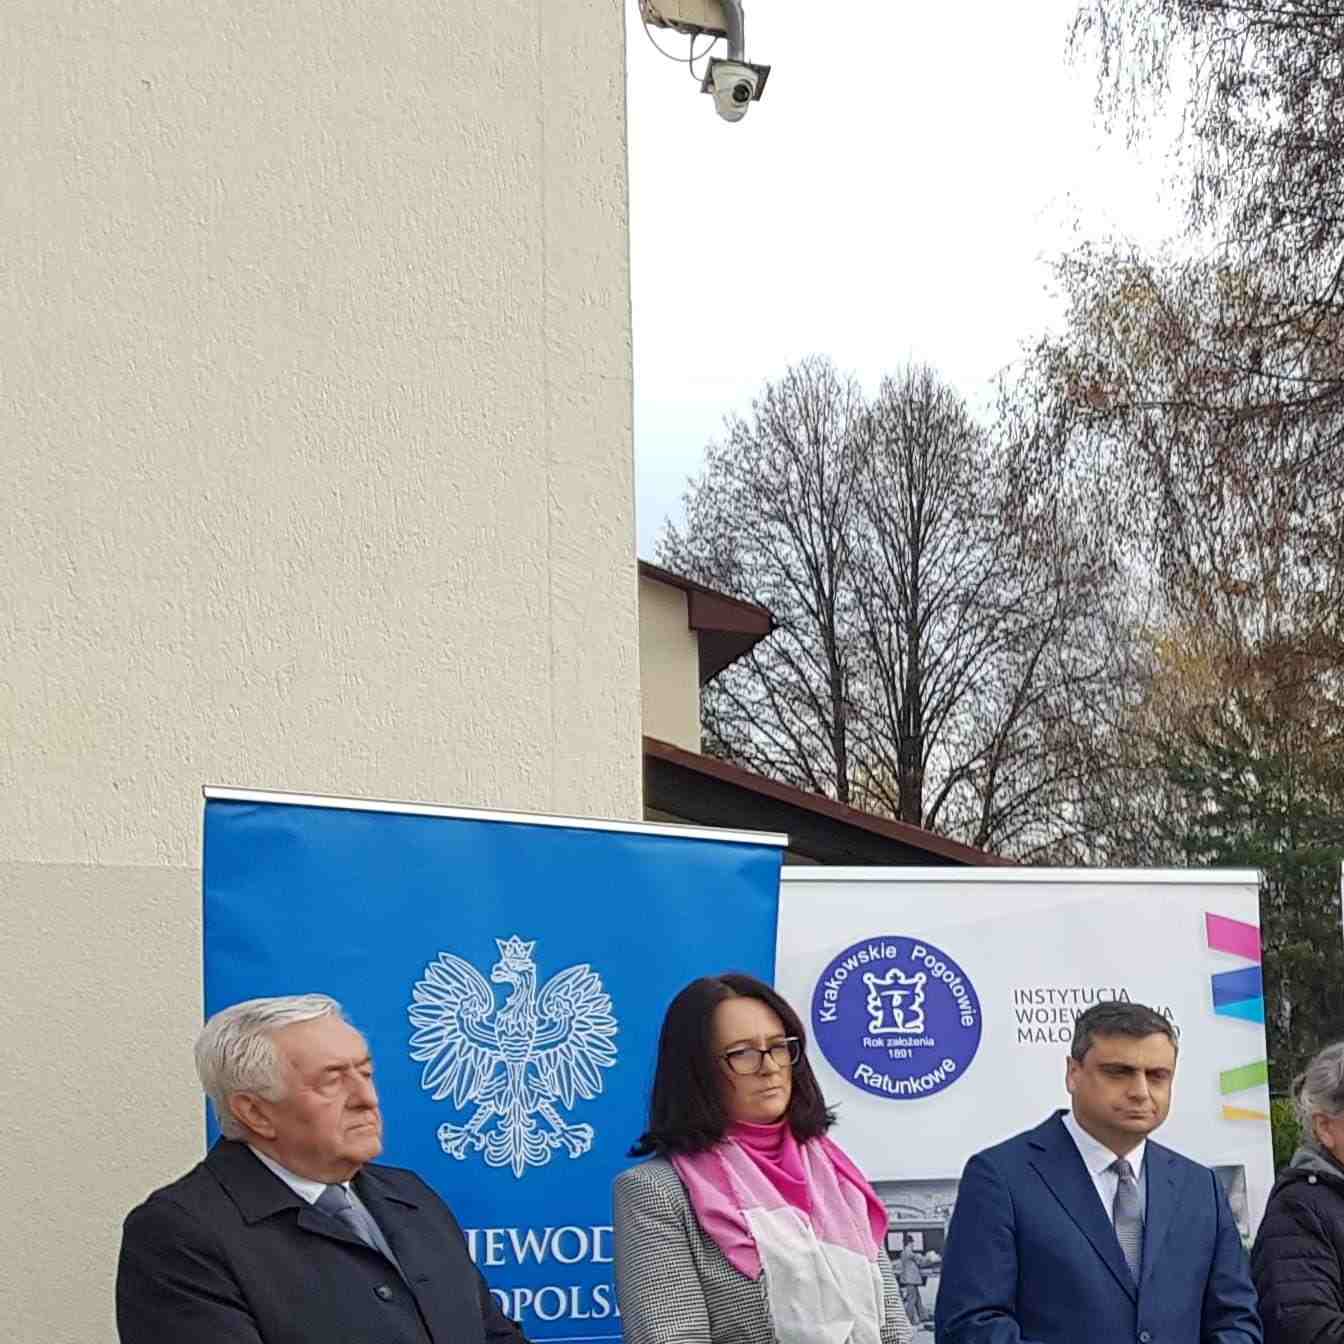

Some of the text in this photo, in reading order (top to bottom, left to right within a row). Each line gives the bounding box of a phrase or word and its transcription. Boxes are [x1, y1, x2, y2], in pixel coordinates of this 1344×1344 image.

[819, 942, 977, 1027] Krakowskie Pogotowie
[1014, 988, 1131, 1005] INSTYTUCJA
[853, 1058, 956, 1095] Ratunkowe
